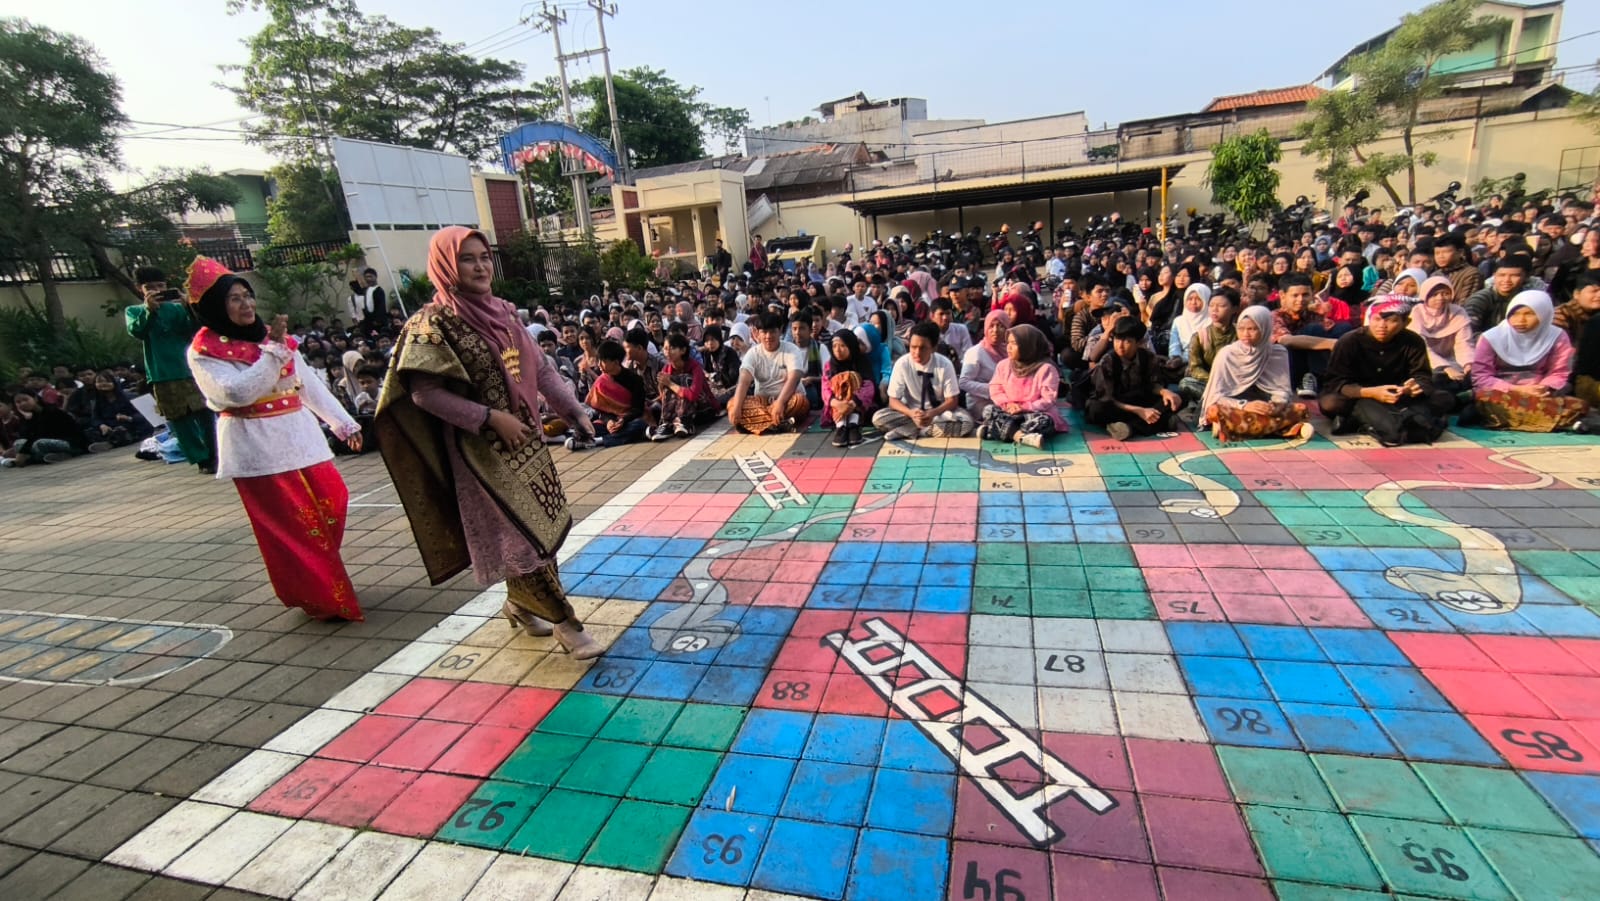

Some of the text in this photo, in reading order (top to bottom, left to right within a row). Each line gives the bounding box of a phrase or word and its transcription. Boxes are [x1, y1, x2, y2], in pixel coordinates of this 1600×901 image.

[1254, 479, 1283, 487] 56
[724, 526, 752, 536] 69
[852, 527, 877, 538] 68
[985, 528, 1016, 539] 67
[1135, 529, 1166, 539] 66
[1305, 530, 1343, 541] 65
[991, 595, 1016, 608] 74
[1168, 600, 1208, 615] 75
[1386, 608, 1431, 624] 76
[440, 654, 480, 669] 90
[1044, 654, 1086, 673] 87
[592, 666, 637, 689] 89
[771, 681, 811, 701] 88
[1217, 707, 1271, 735] 86
[1501, 729, 1584, 762] 85
[455, 799, 517, 831] 92
[702, 833, 746, 865] 93
[1402, 842, 1469, 881] 95
[963, 860, 1027, 901] 94
